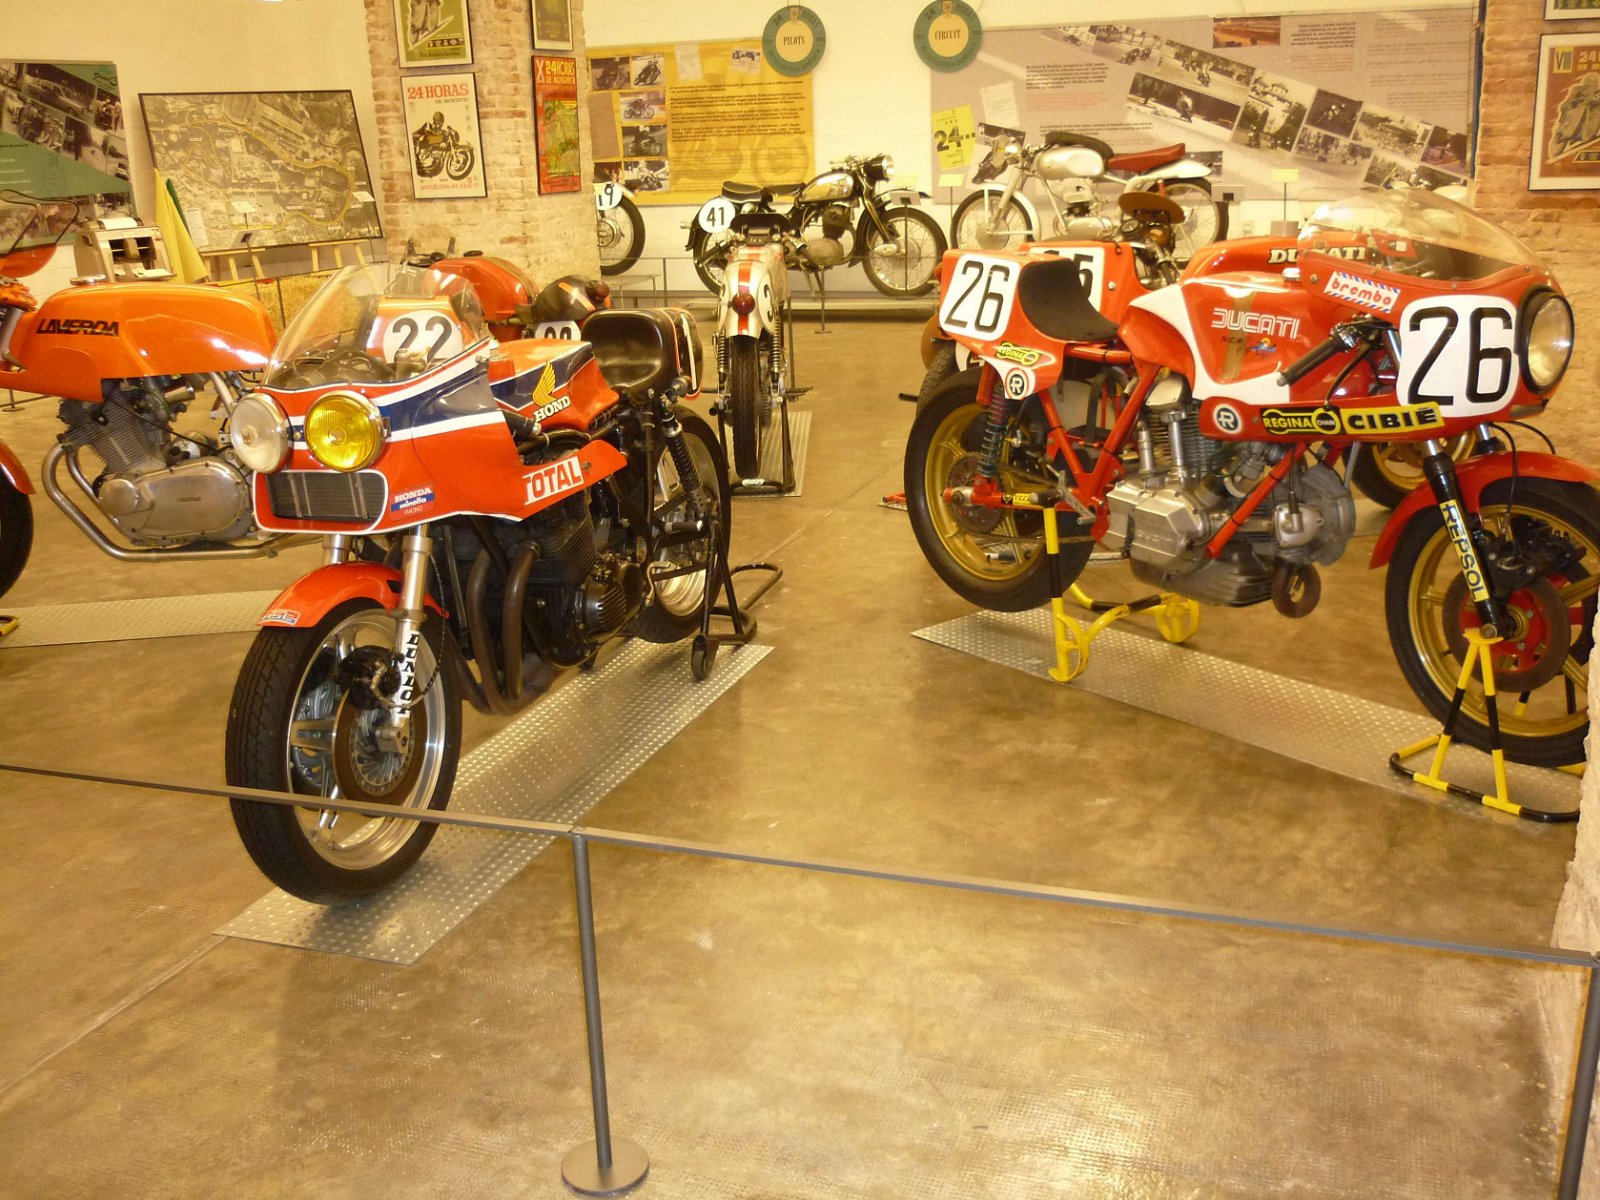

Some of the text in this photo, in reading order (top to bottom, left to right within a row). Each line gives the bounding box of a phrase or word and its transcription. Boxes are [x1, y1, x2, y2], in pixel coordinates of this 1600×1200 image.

[783, 35, 806, 46] PILOTS
[934, 29, 961, 41] CIRCUIT
[407, 83, 469, 100] 24 HORAS
[934, 126, 964, 152] 24
[706, 206, 725, 227] 41
[1268, 246, 1366, 264] DUATI
[944, 260, 1010, 333] 26
[1331, 278, 1392, 306] brembo
[36, 319, 119, 336] LAVERDA
[1211, 307, 1300, 339] DUCATI
[392, 315, 452, 364] 22
[1408, 306, 1512, 405] 26
[1263, 417, 1313, 428] REGINA
[394, 487, 432, 503] HONDA
[1442, 503, 1484, 600] REPSOL
